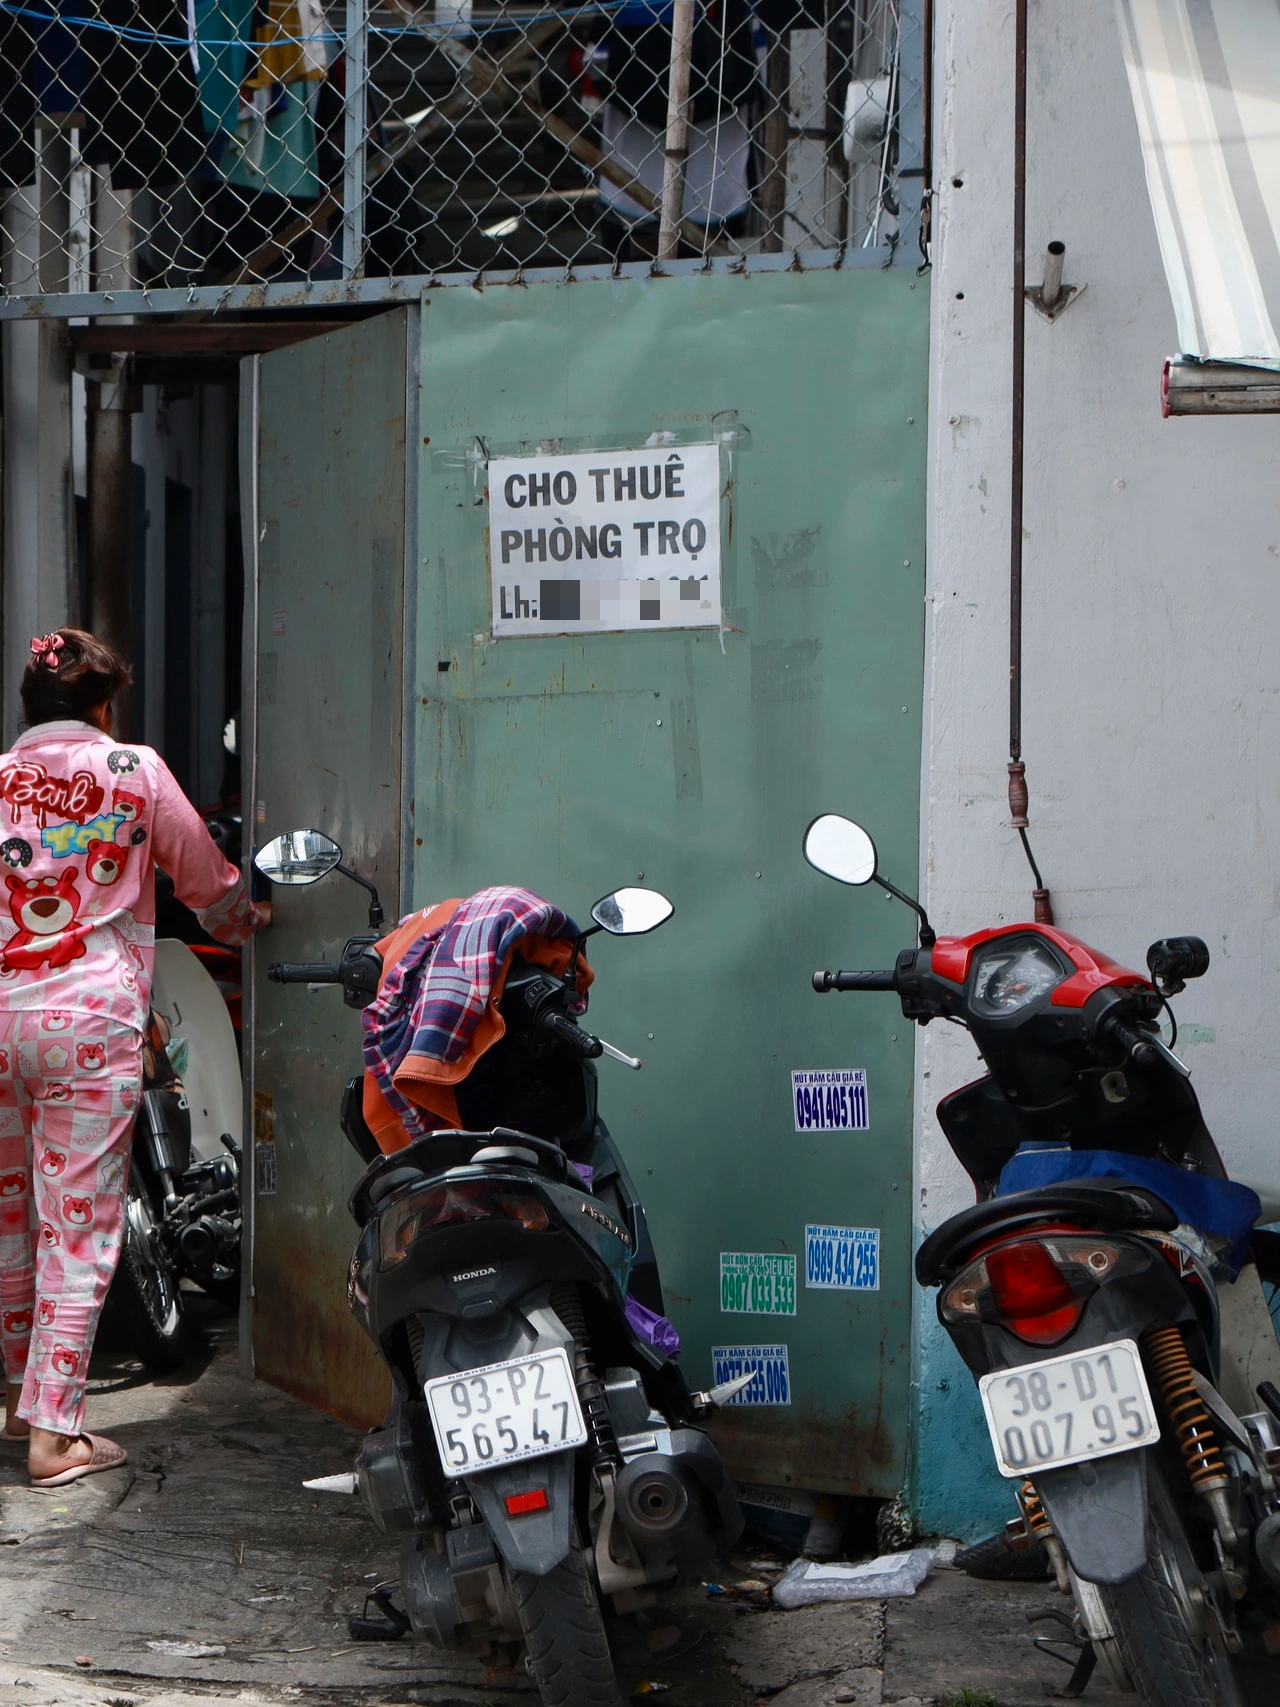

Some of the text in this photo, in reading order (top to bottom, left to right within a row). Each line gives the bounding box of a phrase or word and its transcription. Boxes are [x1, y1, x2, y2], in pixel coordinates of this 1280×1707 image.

[504, 453, 685, 509] CHO THUÊ
[500, 517, 707, 565] PHÒNG TRỌ
[795, 1072, 807, 1083] HÚT
[809, 1071, 825, 1083] HẦM
[826, 1071, 840, 1082] CẦU
[842, 1071, 853, 1082] GIÁ
[796, 1086, 866, 1128] 0941.405.111
[73, 1120, 107, 1147] bear
[808, 1226, 821, 1236] HÚT
[822, 1226, 838, 1238] HẦM
[840, 1228, 854, 1239] CẦU
[855, 1229, 867, 1240] GIÁ
[452, 1266, 497, 1283] HONDA
[808, 1238, 876, 1288] 0989.434.255
[722, 1273, 795, 1314] 0987.033.533
[714, 1347, 727, 1358] HÚT
[449, 1362, 552, 1419] 93-P2
[1004, 1353, 1120, 1418] 38-D1
[445, 1401, 569, 1467] 565.47
[504, 1446, 551, 1461] HOANG
[552, 1437, 581, 1449] CAU
[1002, 1395, 1144, 1467] 007.95
